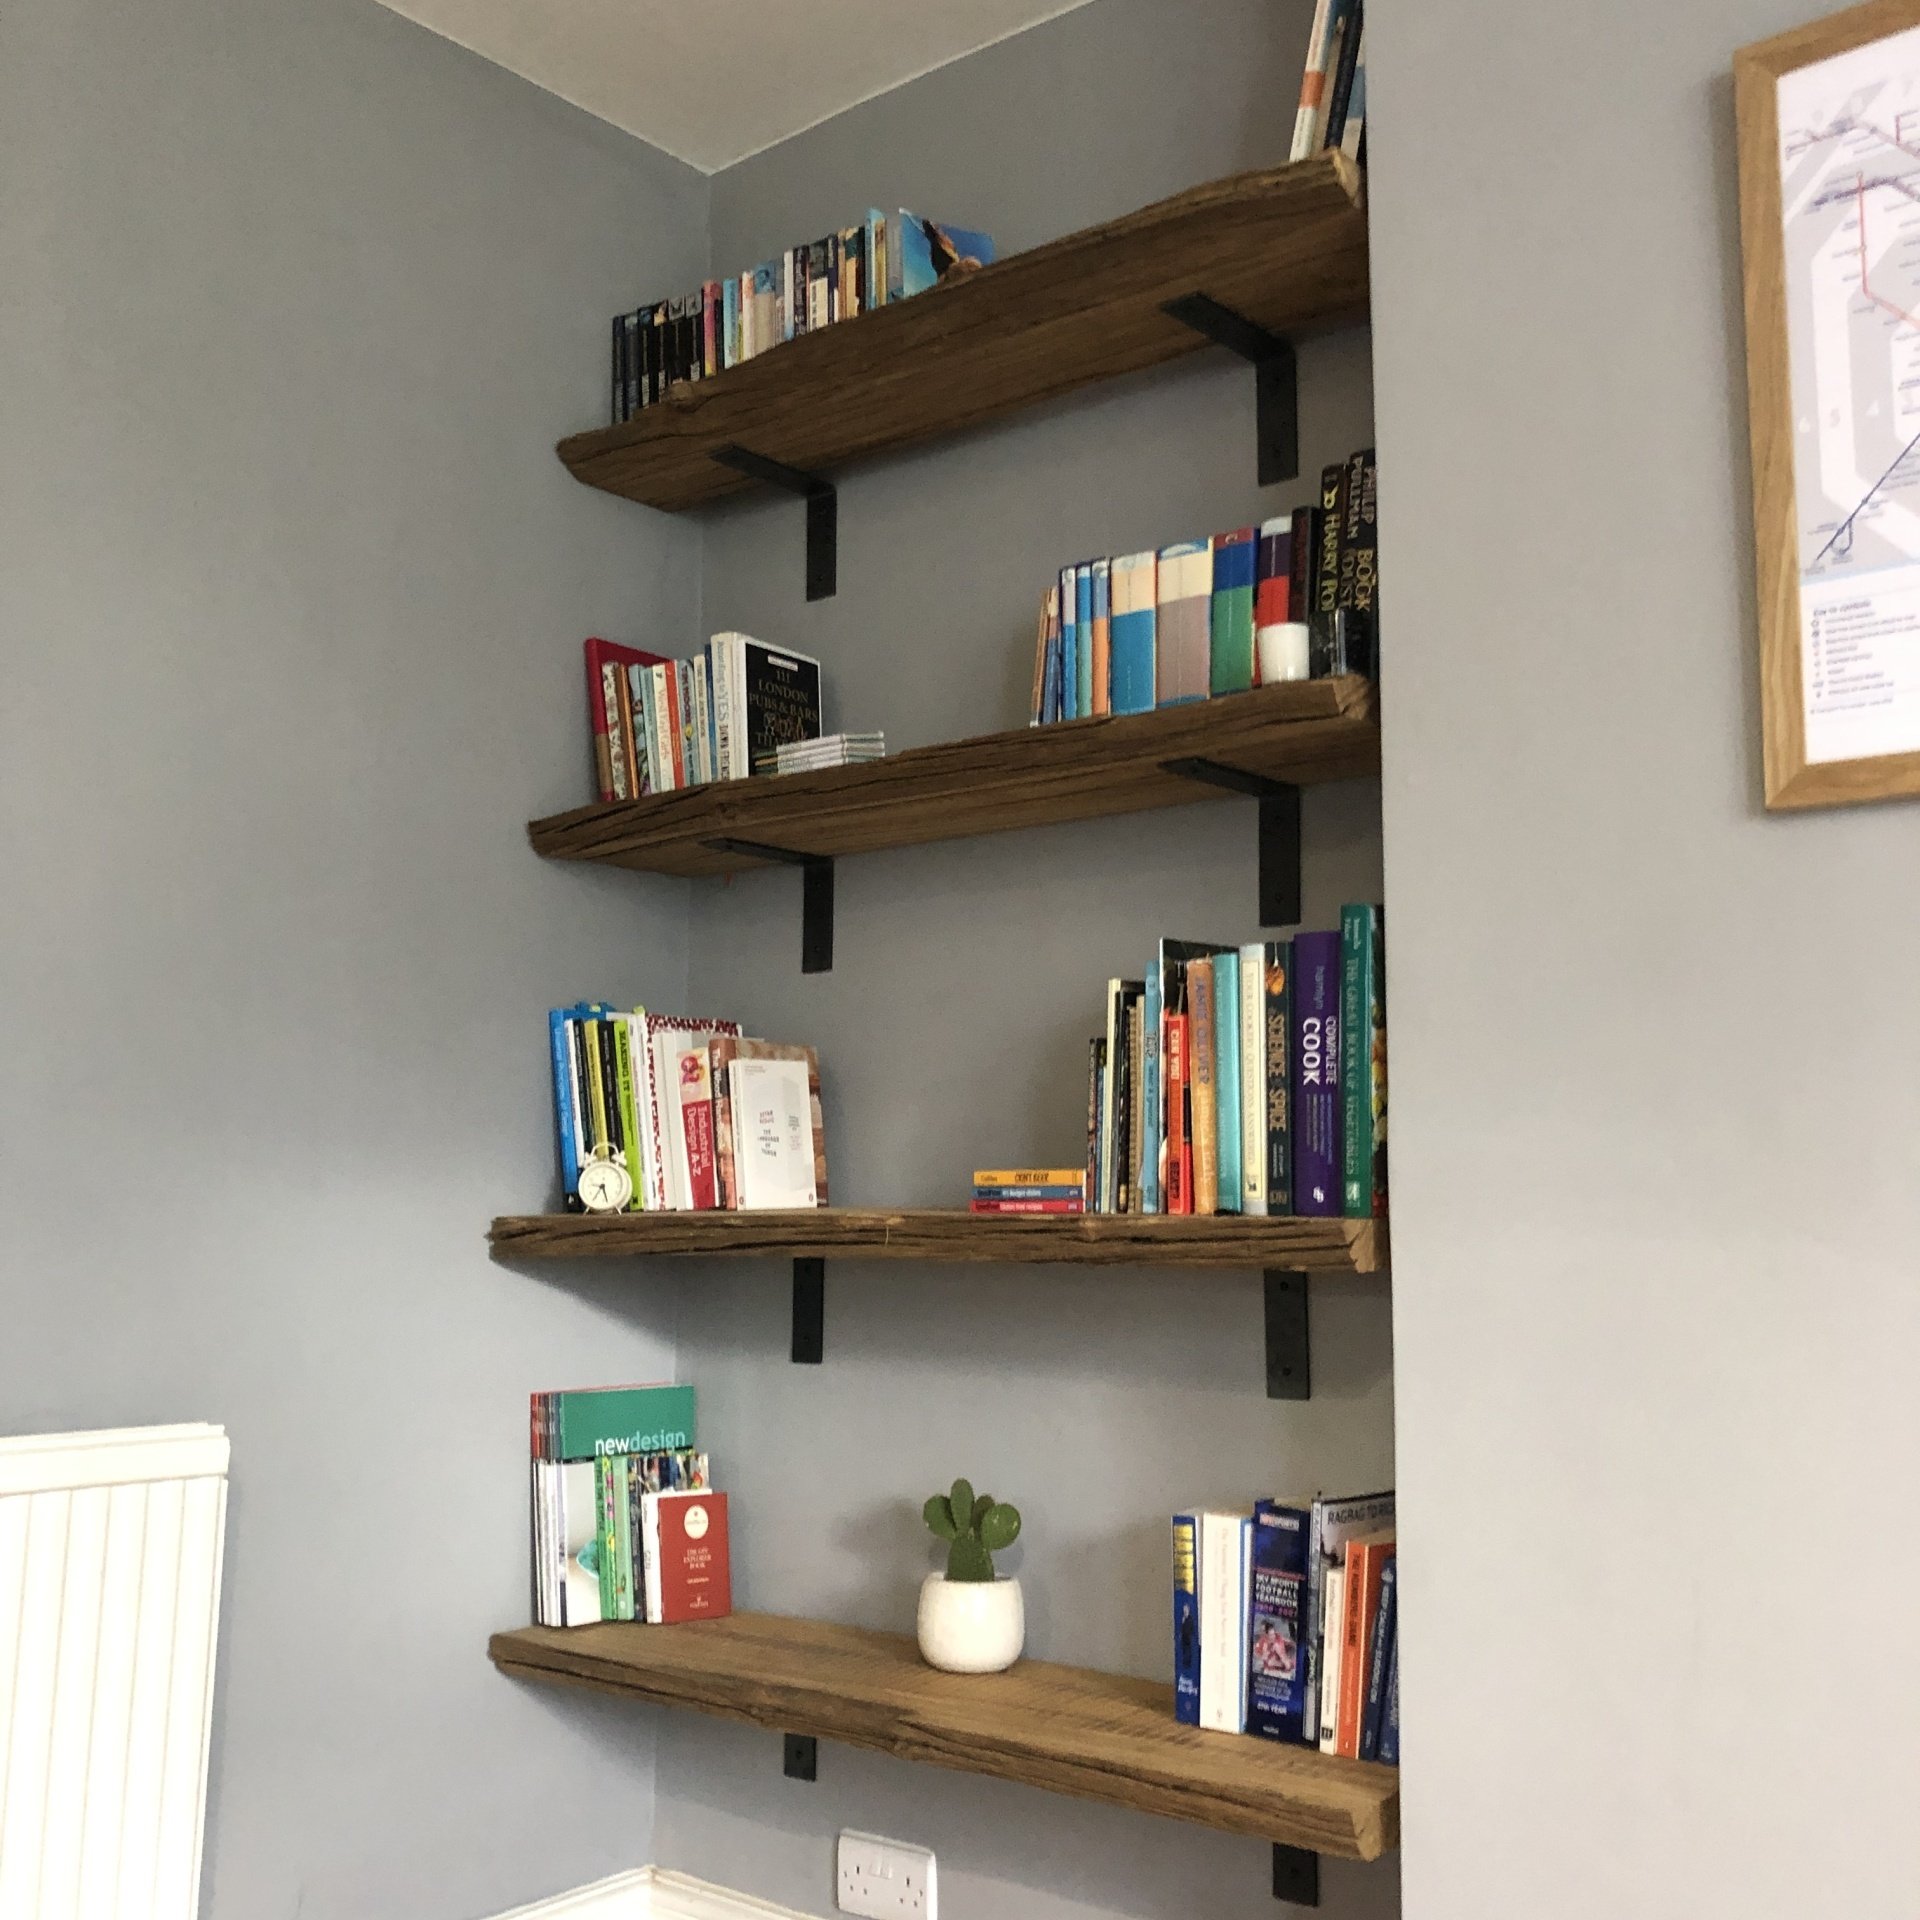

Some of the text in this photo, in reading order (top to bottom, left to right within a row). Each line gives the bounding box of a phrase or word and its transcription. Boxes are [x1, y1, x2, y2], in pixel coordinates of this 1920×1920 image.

[1347, 456, 1363, 539] PULLMAN
[1361, 466, 1376, 524] PHILIP
[1323, 514, 1340, 574] HARRY
[1355, 549, 1373, 612] BOOK
[718, 692, 729, 721] YES
[749, 693, 818, 721] PUBS & BARS
[758, 678, 808, 703] LONDON
[1245, 1002, 1255, 1049] COOKERY
[1268, 1015, 1285, 1077] SCIENCE
[1325, 1015, 1337, 1086] COMPLETE
[1346, 1032, 1358, 1068] BOOK
[619, 1030, 630, 1077] MAKING
[1302, 1017, 1321, 1086] COOK
[623, 1080, 630, 1091] IT
[712, 1048, 724, 1152] The Wood Handbook
[1245, 1053, 1256, 1108] QUESTIONS
[1268, 1087, 1286, 1132] SPICE
[1345, 1095, 1359, 1175] VEGETABLES
[687, 1109, 701, 1177] Design A-Z
[698, 1107, 710, 1168] Industrial
[595, 1430, 686, 1456] newdesign
[1328, 1507, 1366, 1525] RAGBAG
[1256, 1583, 1297, 1597] FOOTBALL
[1256, 1593, 1297, 1608] YEARBOOK
